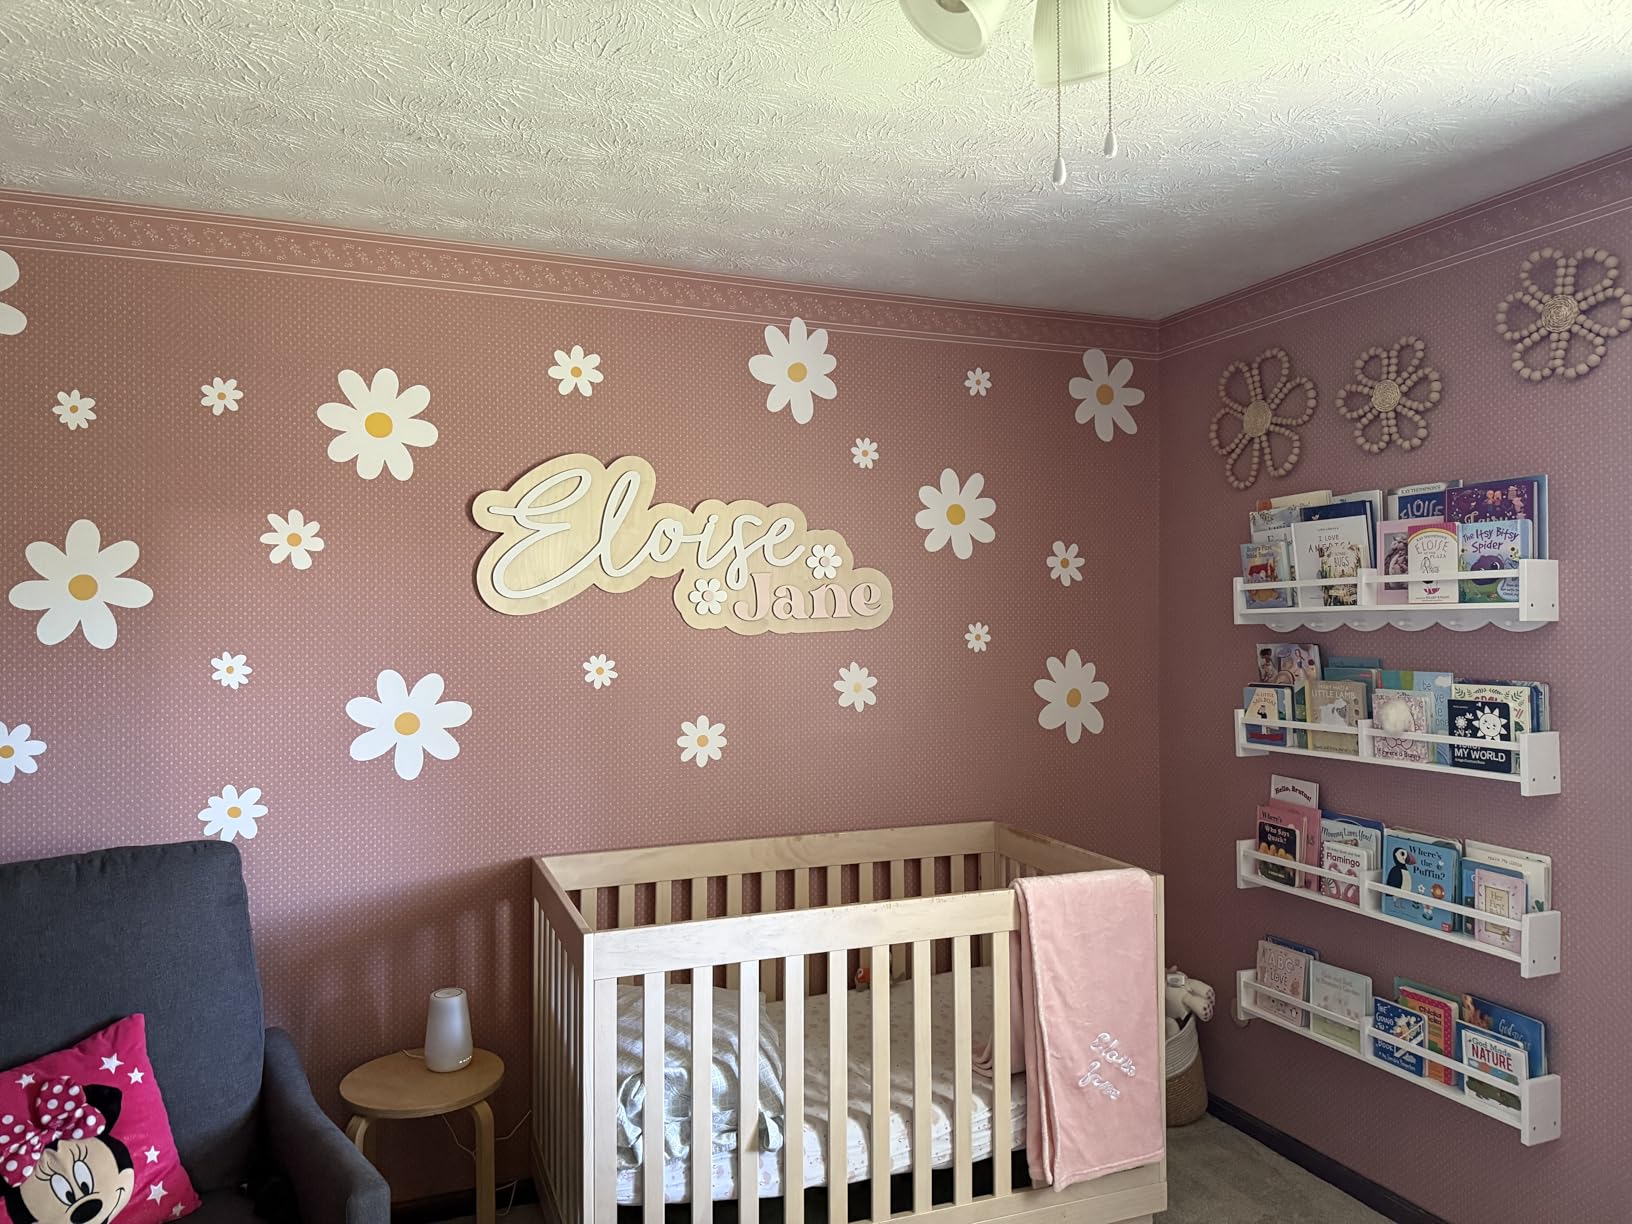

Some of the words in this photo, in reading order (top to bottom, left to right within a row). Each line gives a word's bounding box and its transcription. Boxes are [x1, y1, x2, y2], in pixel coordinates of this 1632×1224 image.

[1400, 499, 1444, 519] ELOISE
[487, 468, 806, 598] Eloise
[1463, 533, 1475, 543] The
[1476, 528, 1494, 541] Itsy
[1496, 526, 1519, 542] Bitsy
[1414, 539, 1449, 554] ELOISE
[1471, 541, 1504, 553] Spider
[1333, 555, 1350, 568] BUGS
[731, 572, 883, 621] Jane
[1311, 689, 1334, 698] LITTLE
[1335, 691, 1355, 699] LAMB
[1454, 748, 1469, 757] MY
[1472, 750, 1506, 762] WORLD
[1274, 785, 1291, 795] Hello,
[1261, 810, 1282, 823] Where's
[1264, 825, 1277, 834] Who
[1277, 828, 1290, 838] Says
[1267, 833, 1287, 844] Quack?
[1343, 828, 1359, 838] Loves
[1358, 829, 1373, 841] You!
[1326, 852, 1361, 868] Flamingo
[1408, 845, 1443, 861] Where's
[1420, 859, 1433, 868] the
[1412, 865, 1446, 881] Puffin?
[1490, 890, 1504, 901] Her
[1270, 953, 1296, 973] ABC
[1270, 972, 1288, 987] LOVE
[1377, 1003, 1388, 1015] THE
[1418, 1005, 1442, 1019] Chicka
[1376, 1013, 1394, 1027] GOING
[1377, 1022, 1385, 1030] TO
[1498, 1018, 1514, 1037] God
[1470, 1037, 1489, 1048] God
[1489, 1043, 1512, 1057] Made
[1471, 1043, 1513, 1072] NATURE
